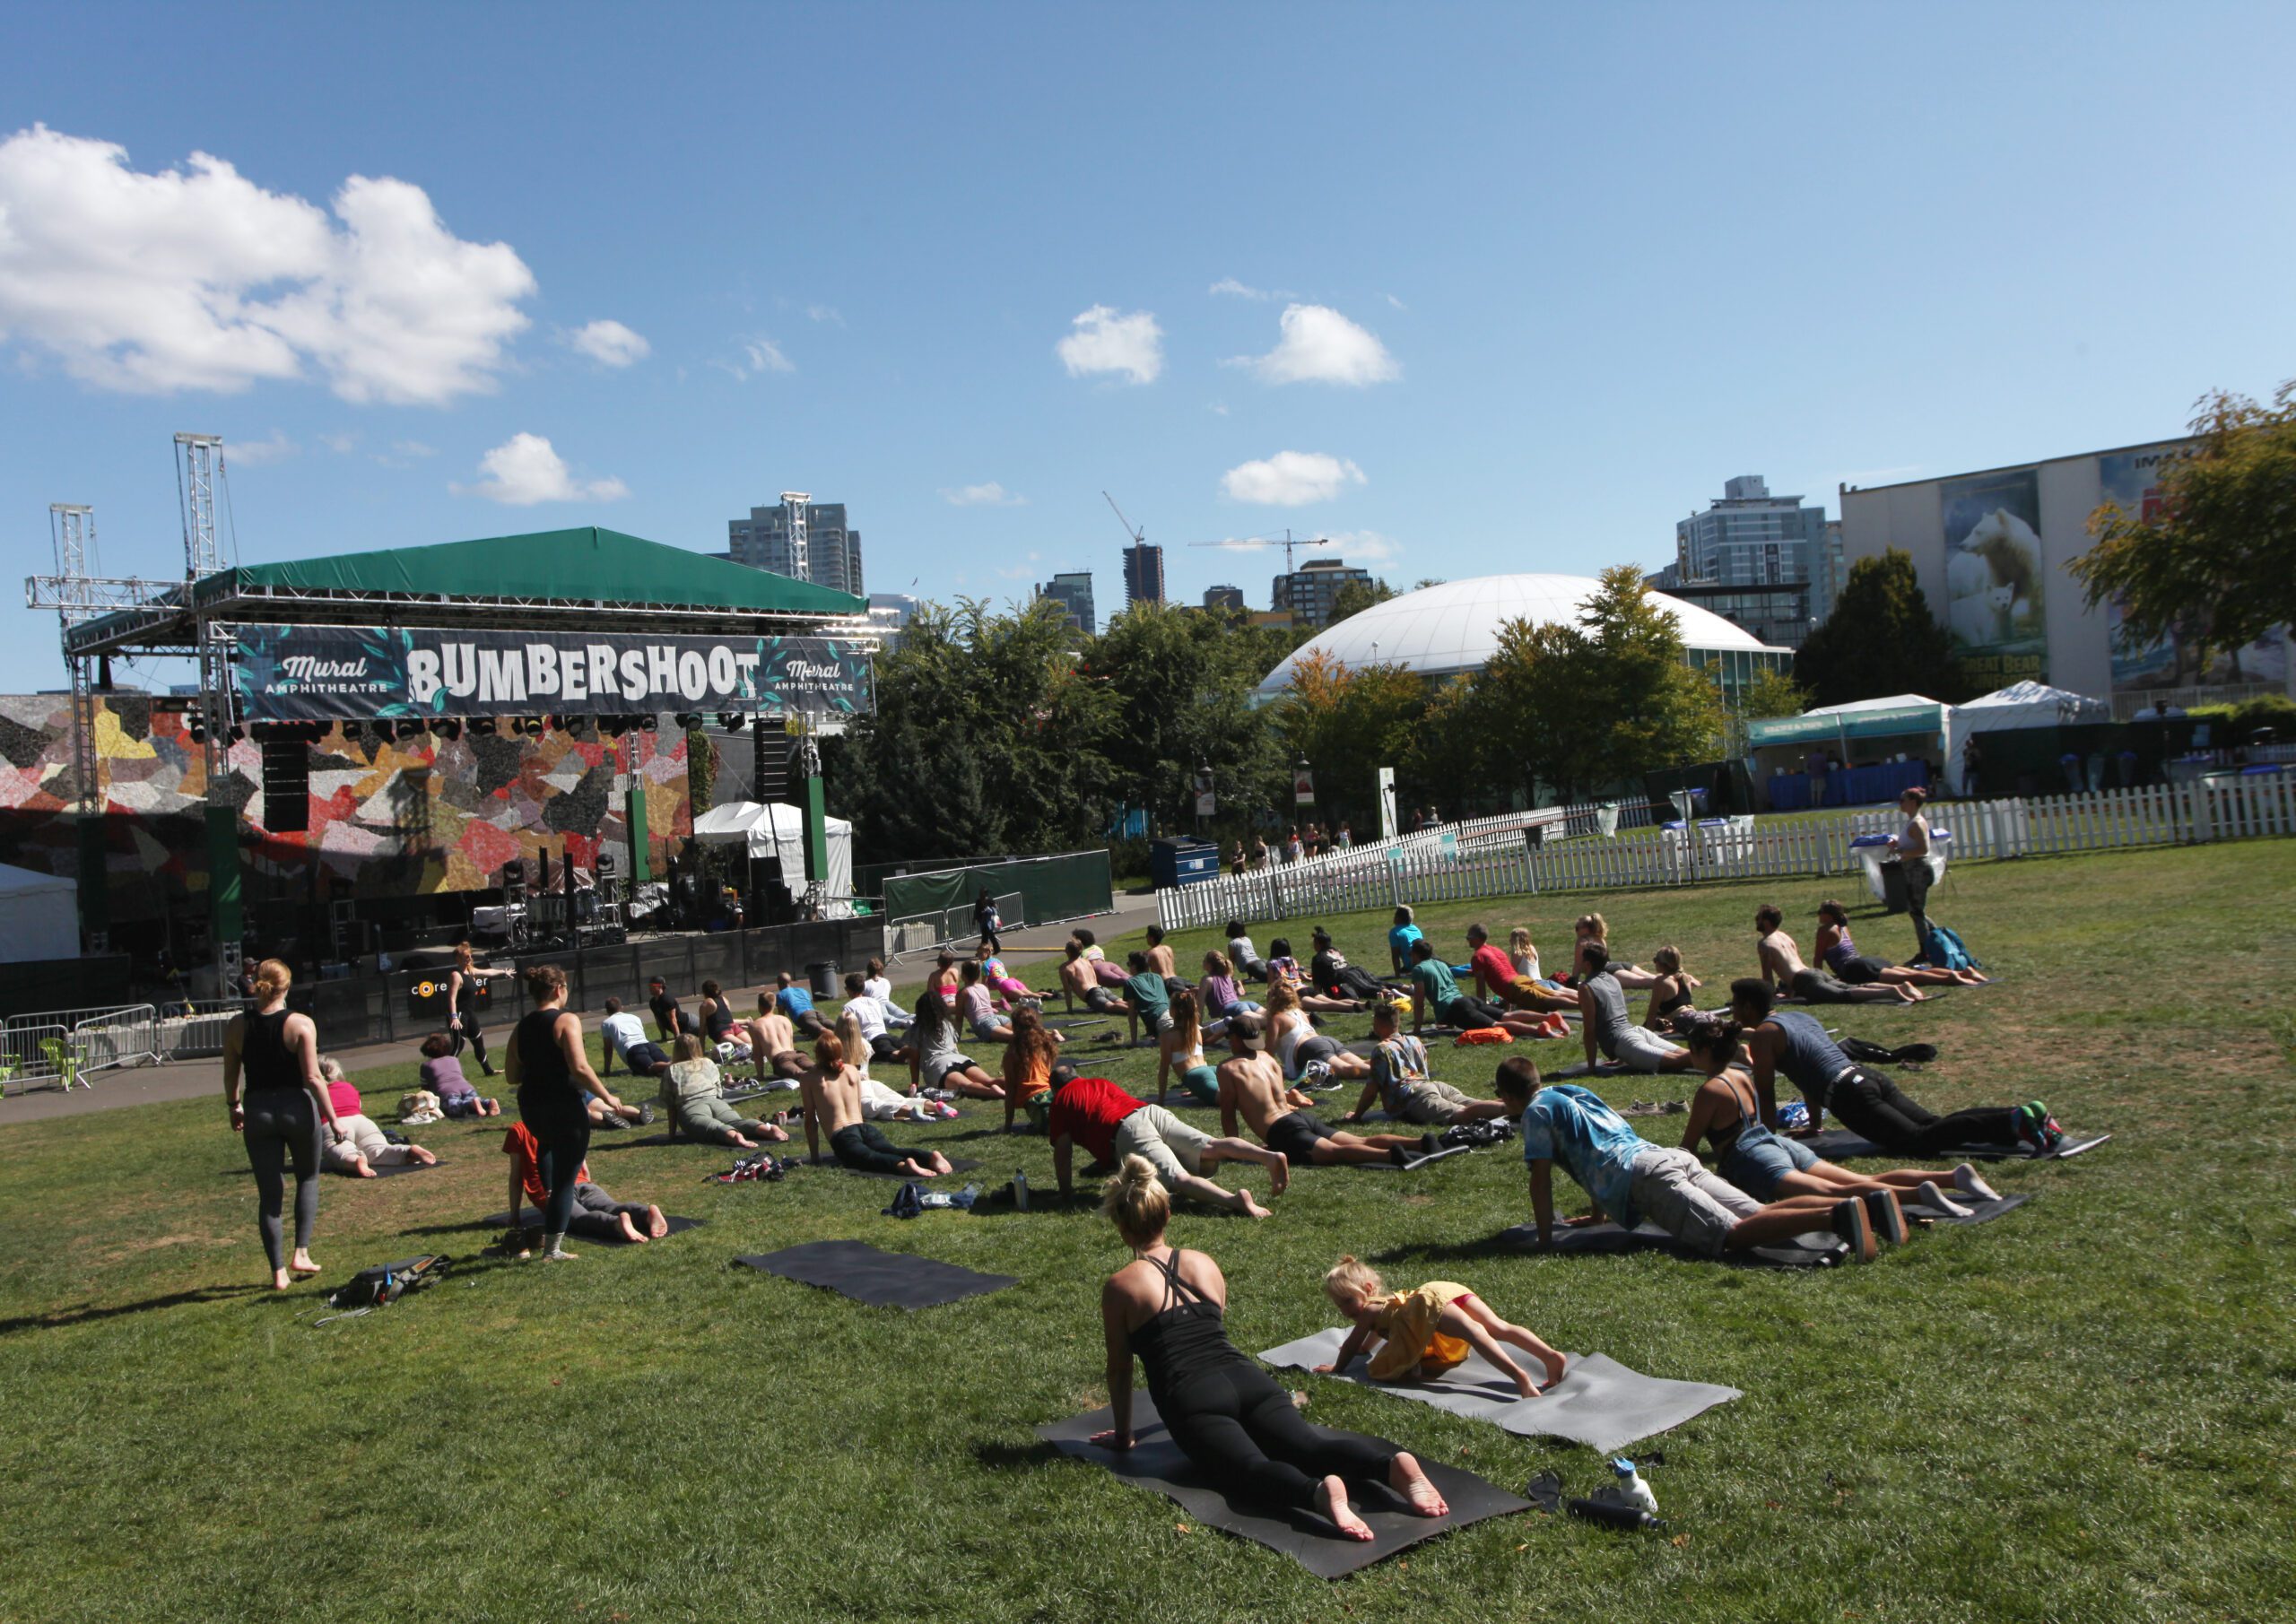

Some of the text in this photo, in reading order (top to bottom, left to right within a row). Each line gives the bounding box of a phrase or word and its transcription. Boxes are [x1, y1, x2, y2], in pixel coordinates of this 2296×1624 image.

[282, 656, 368, 682] Mural
[407, 643, 760, 703] BUMBERSHOOT
[786, 660, 840, 682] Mural
[2003, 655, 2039, 673] BEAR
[265, 683, 387, 694] AMPHITHEATRE
[774, 682, 854, 692] AMPHITHEATRE
